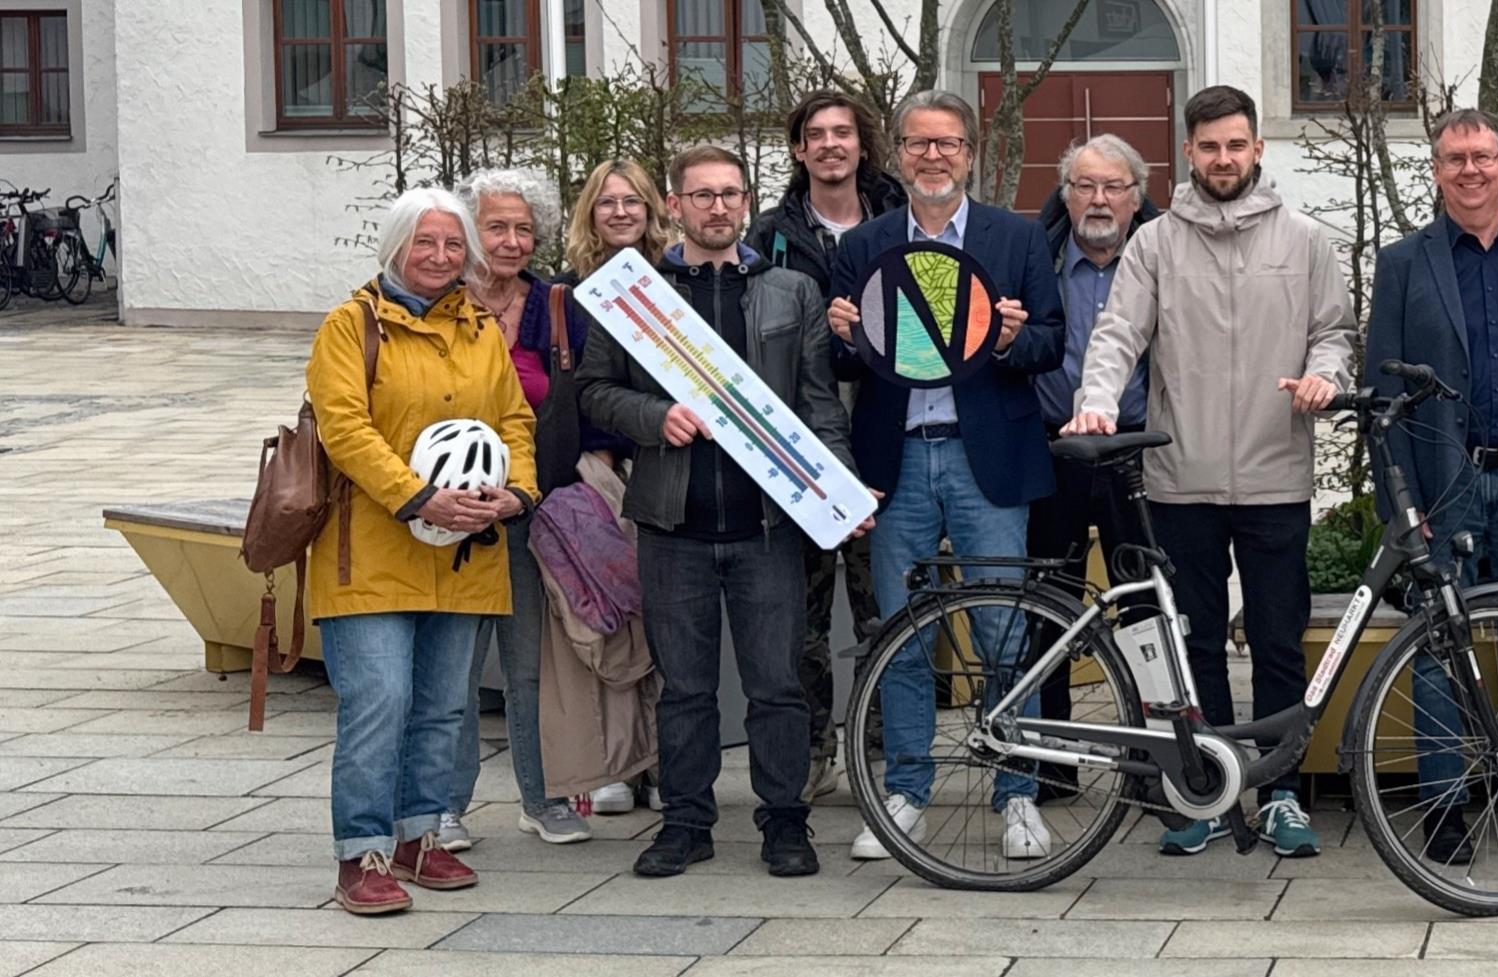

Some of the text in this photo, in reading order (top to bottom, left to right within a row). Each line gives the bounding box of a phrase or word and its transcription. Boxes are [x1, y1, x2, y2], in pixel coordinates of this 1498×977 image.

[715, 416, 728, 428] 10
[788, 431, 801, 444] 20
[790, 491, 804, 505] -20
[1334, 598, 1361, 645] NEUMARKT
